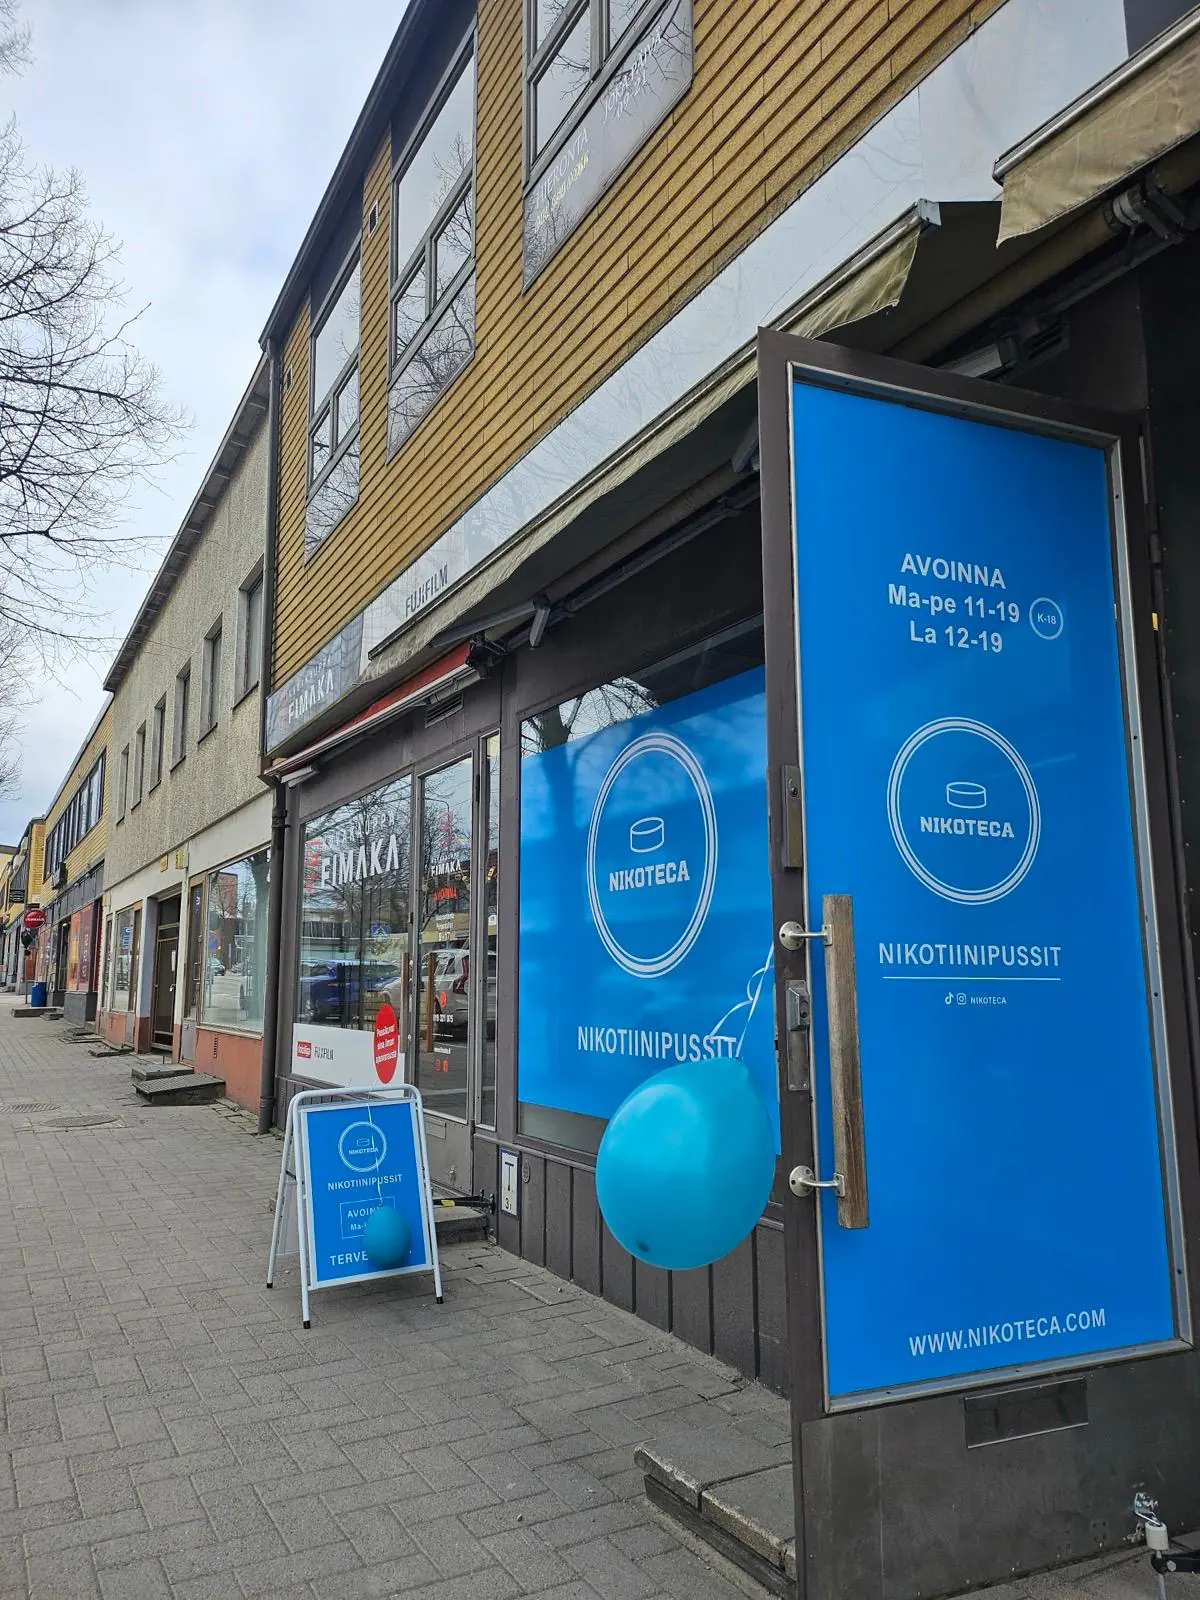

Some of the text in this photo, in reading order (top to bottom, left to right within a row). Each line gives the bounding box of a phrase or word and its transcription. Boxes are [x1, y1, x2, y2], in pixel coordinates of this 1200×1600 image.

[535, 127, 590, 210] HIERONTA
[900, 552, 1007, 590] AVOINNA
[405, 563, 449, 618] FUJIFILM
[888, 583, 1020, 623] Ma-pe 11-19
[1037, 612, 1058, 625] K-18
[910, 619, 1003, 653] La 12-19
[288, 669, 334, 724] FIMAKA
[919, 816, 1015, 838] NIKOTECA
[321, 834, 399, 890] FIMAKA
[431, 859, 461, 877] FIMAKA
[608, 860, 690, 892] NIKOTECA
[878, 942, 1062, 967] NIKOTIINIPUSSIT
[970, 996, 1007, 1005] NIKOTECA
[577, 1025, 737, 1063] NIKOTIINIPUSSIT
[348, 1147, 379, 1155] NIKOTECA
[327, 1174, 403, 1191] NIKOTIINIPUSSIT
[347, 1206, 379, 1219] AVOIN
[350, 1221, 367, 1232] Ma-
[329, 1250, 369, 1267] TERVE
[908, 1308, 1106, 1357] WWW.NIKOTECA.COM
